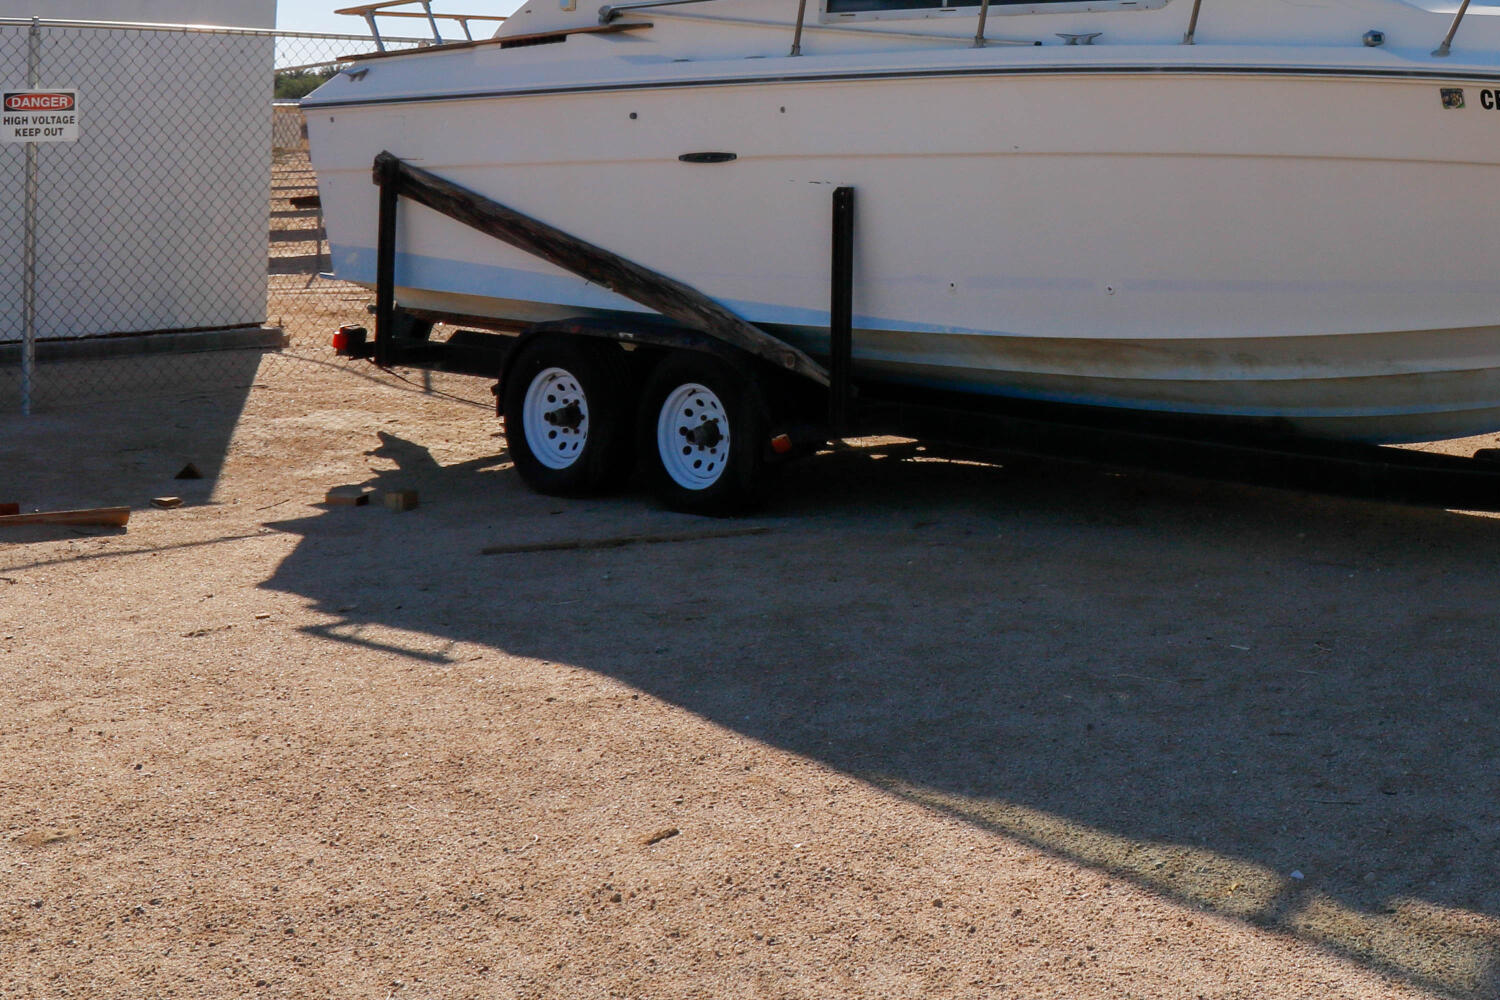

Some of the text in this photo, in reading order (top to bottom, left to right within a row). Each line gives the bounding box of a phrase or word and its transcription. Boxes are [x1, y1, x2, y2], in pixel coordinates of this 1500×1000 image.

[12, 96, 68, 107] DANGER
[3, 115, 75, 125] HIGH VOLTAGE
[14, 127, 64, 137] KEEP OUT
